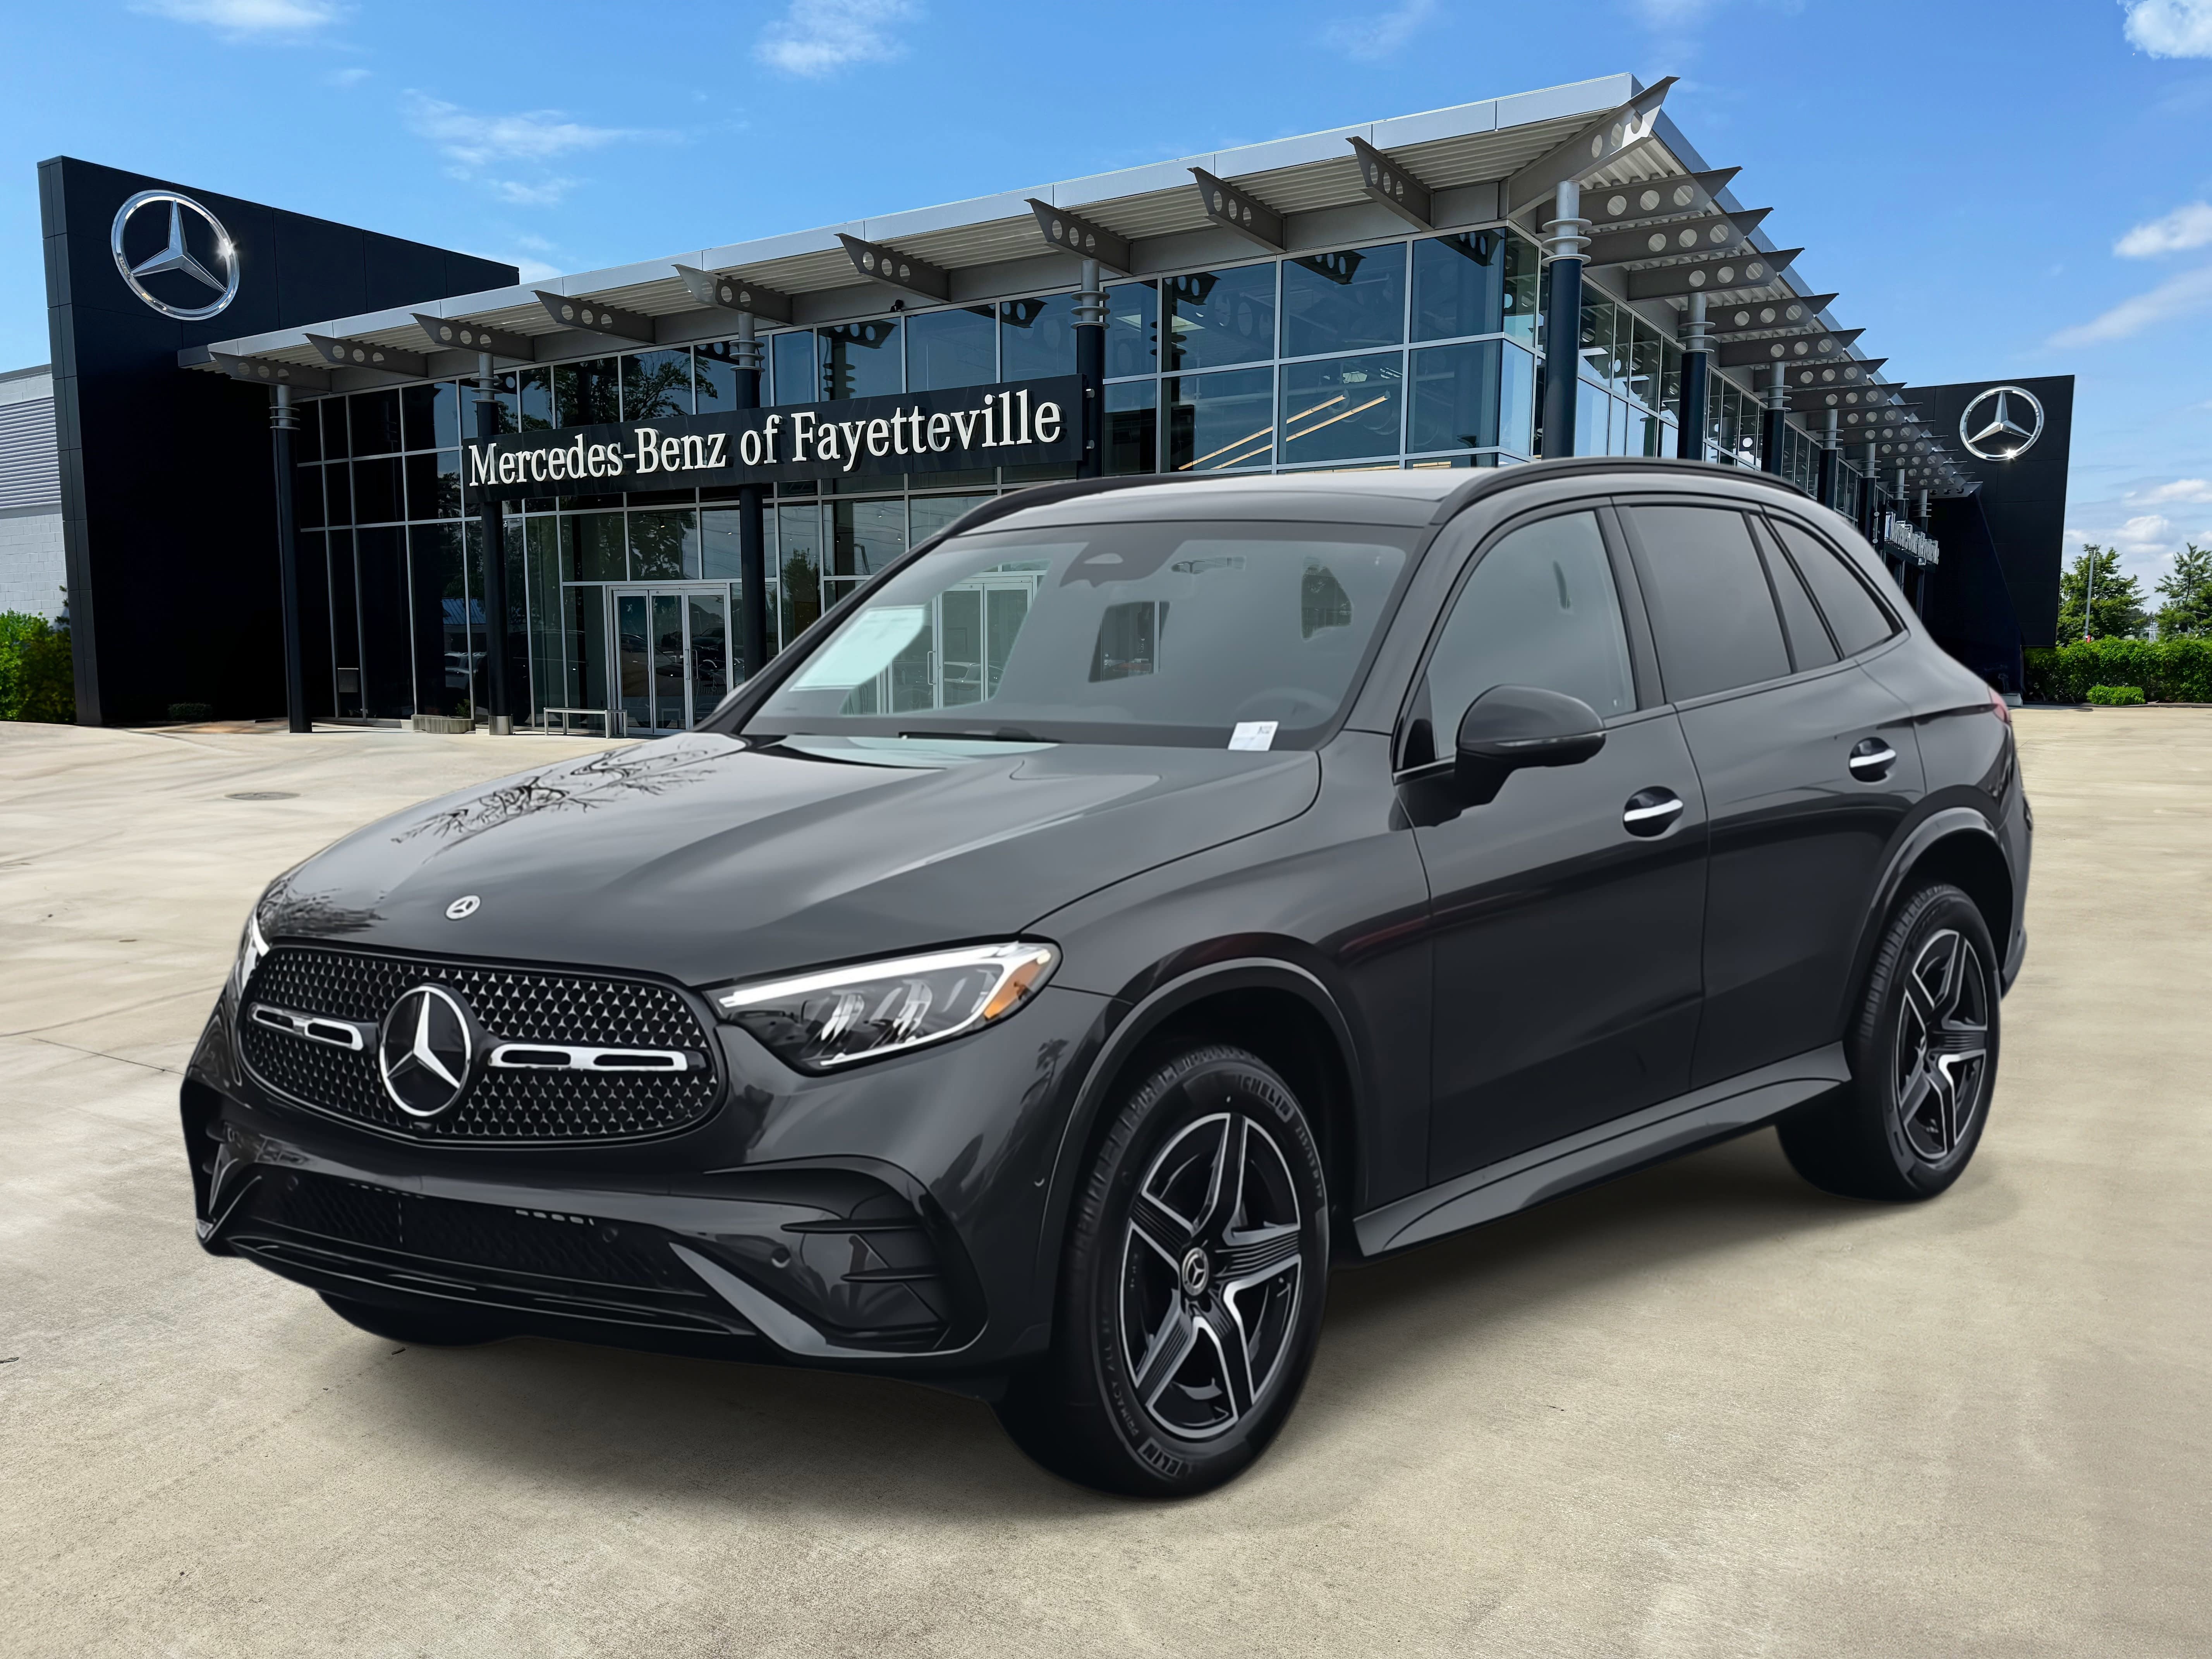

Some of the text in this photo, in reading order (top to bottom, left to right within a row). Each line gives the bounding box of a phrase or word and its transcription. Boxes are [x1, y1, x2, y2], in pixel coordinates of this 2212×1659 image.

[468, 389, 1061, 487] Mercedes-Benz of Fayetteville
